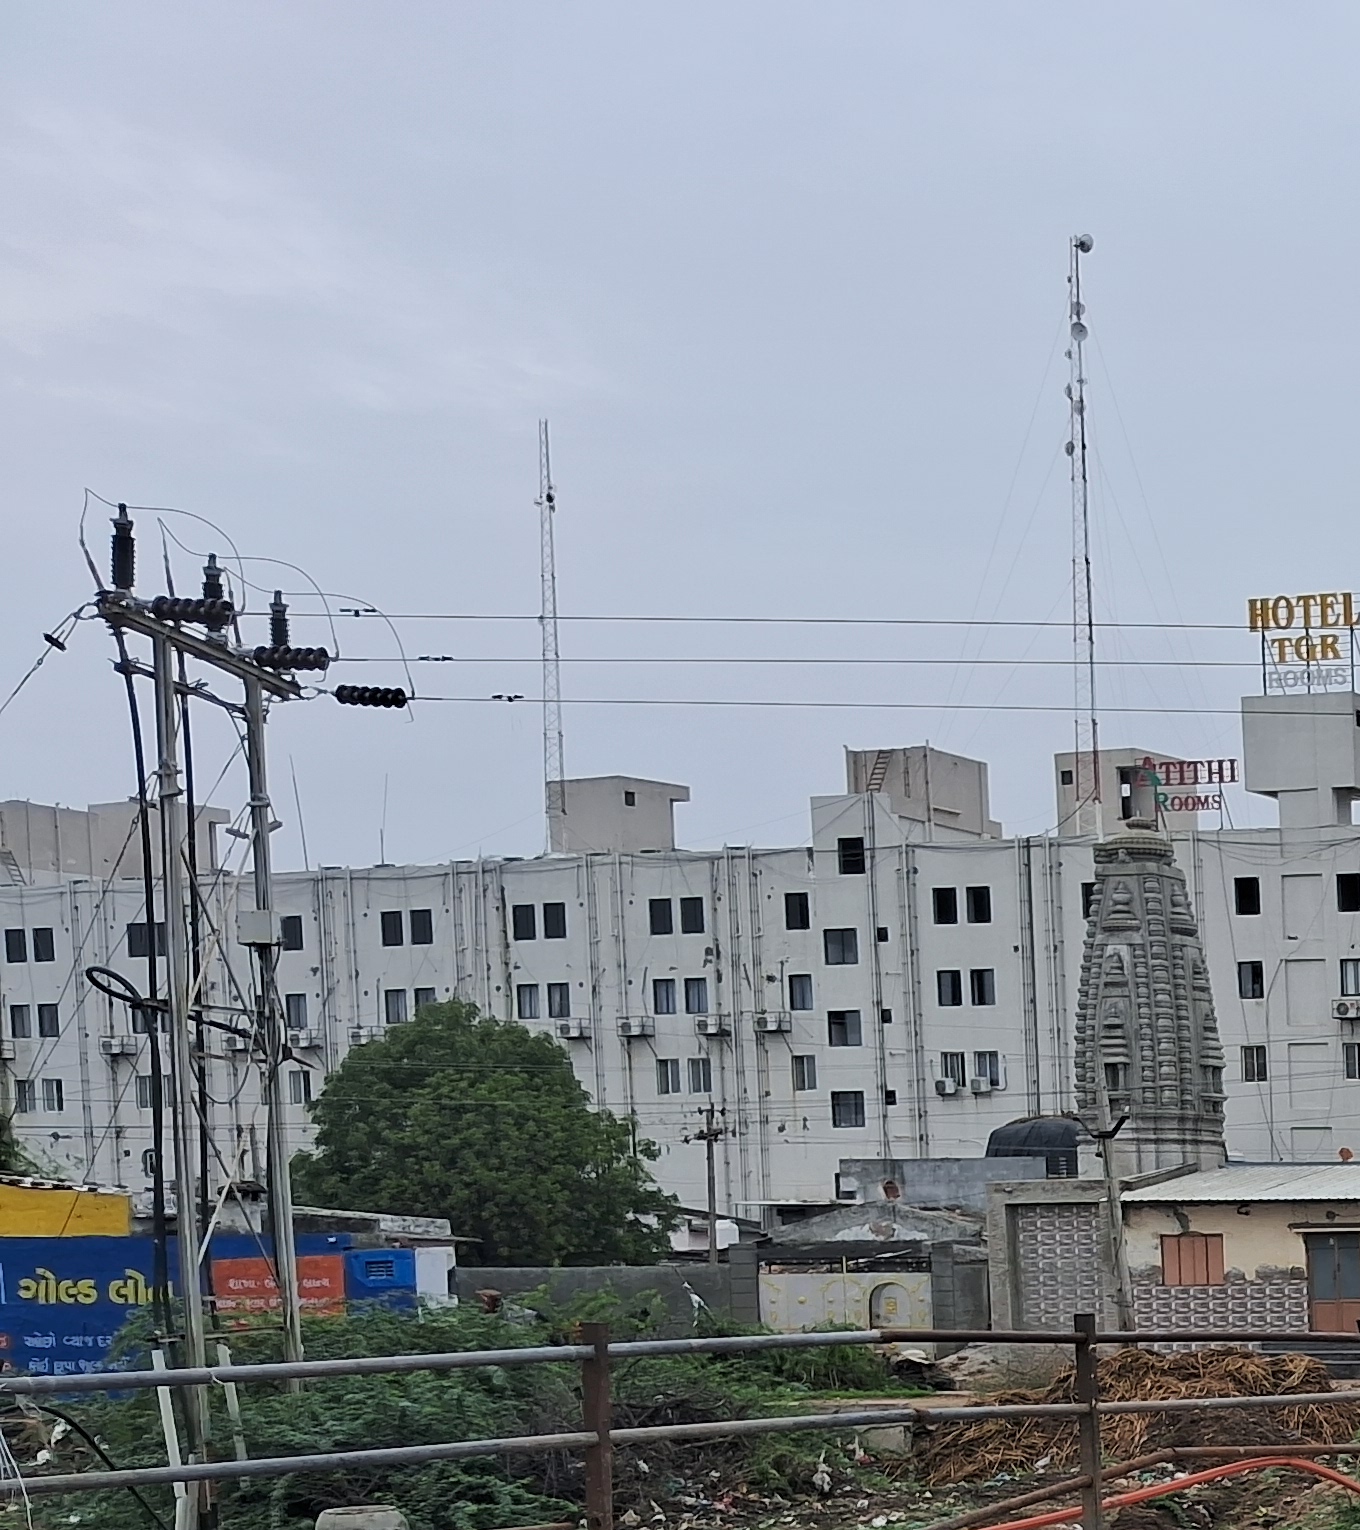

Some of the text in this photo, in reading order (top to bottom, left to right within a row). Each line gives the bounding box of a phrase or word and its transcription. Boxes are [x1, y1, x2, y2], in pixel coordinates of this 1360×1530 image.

[1271, 634, 1342, 663] TGR
[1268, 667, 1348, 689] ROOMS
[1136, 757, 1240, 788] ATITHI
[1155, 792, 1221, 813] ROOMS
[17, 1267, 98, 1305] ગોલ્ડ
